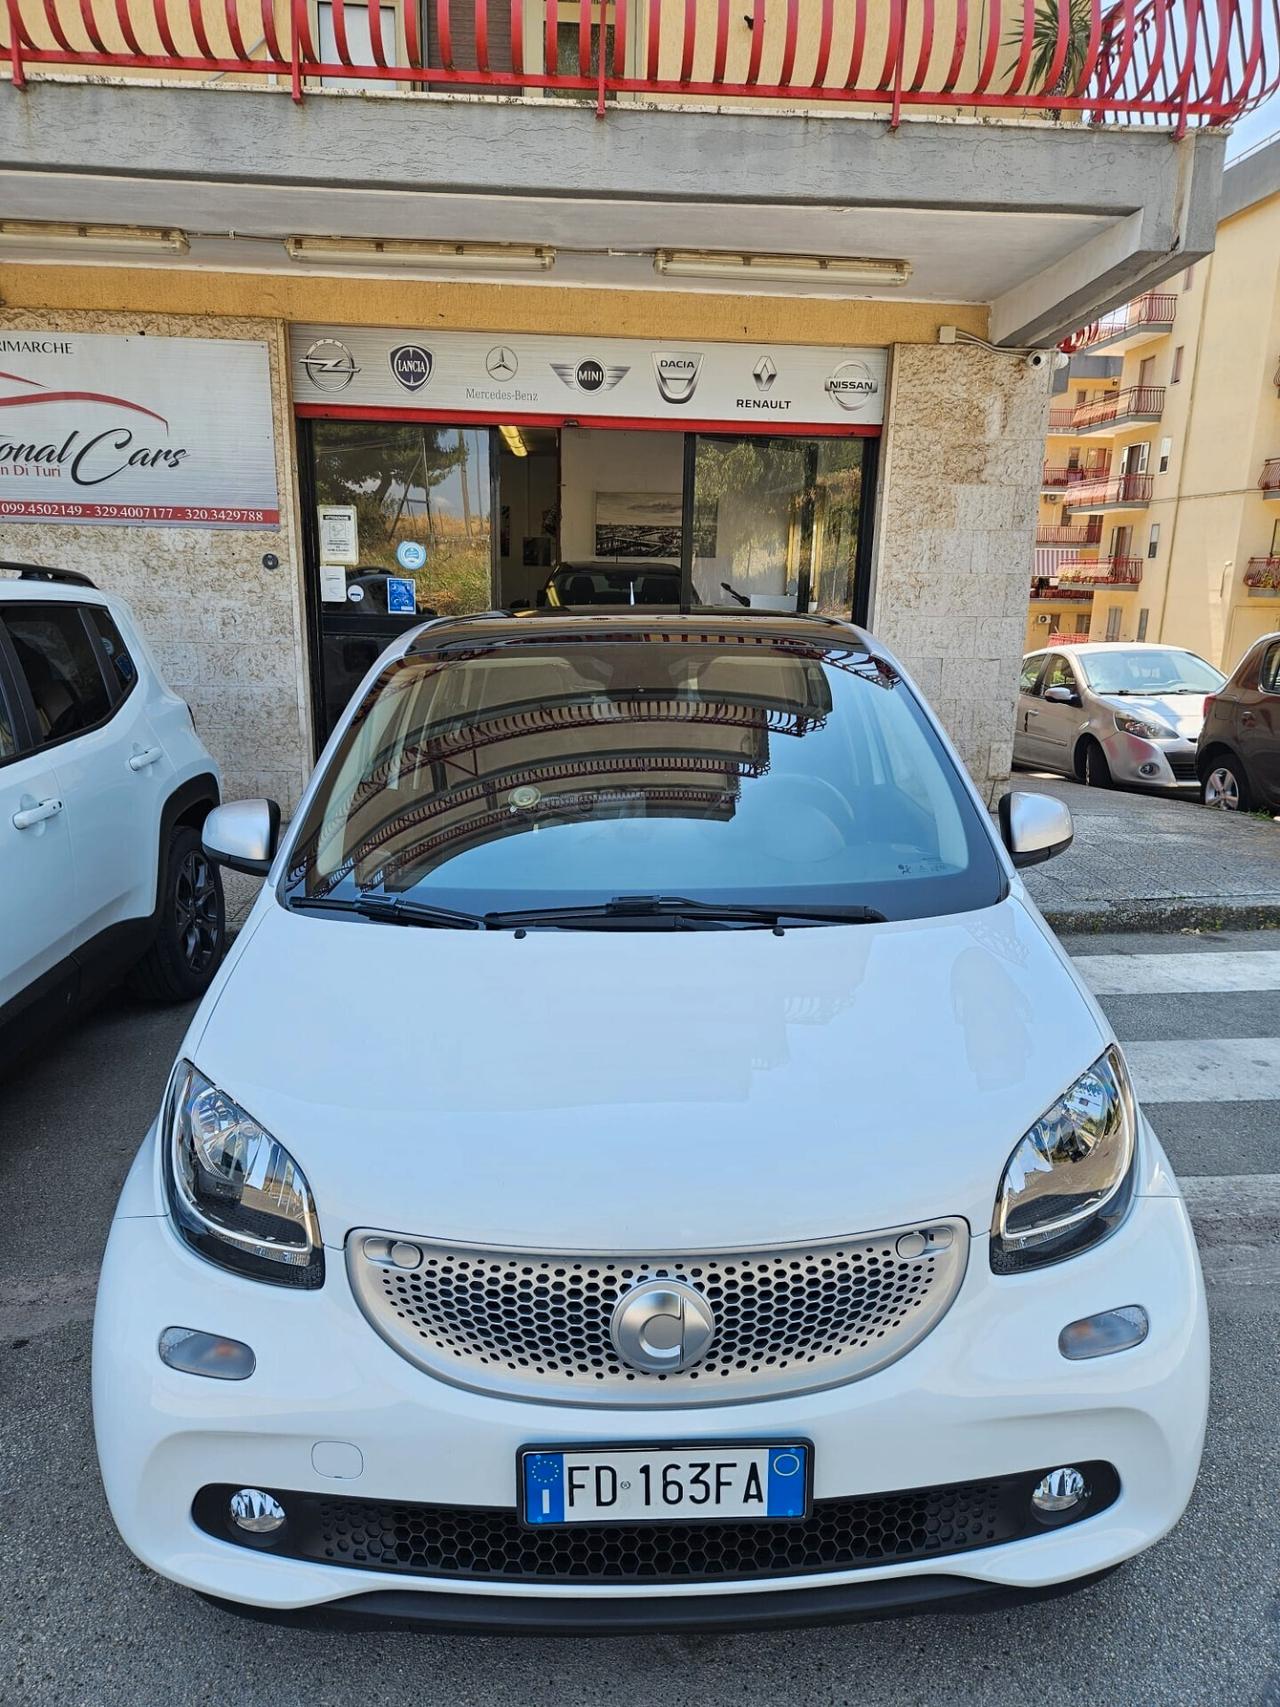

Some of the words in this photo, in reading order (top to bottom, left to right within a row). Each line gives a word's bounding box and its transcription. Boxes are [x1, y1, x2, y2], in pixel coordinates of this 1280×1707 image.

[398, 360, 426, 373] LANCIA
[660, 359, 695, 369] DACIA
[578, 370, 603, 383] MINI
[829, 380, 874, 391] NISSAN
[465, 388, 538, 401] Mercedes-Benz
[736, 399, 792, 410] RENAULT
[71, 428, 190, 486] Cars
[14, 464, 29, 477] Di
[32, 465, 61, 478] Turi
[1, 503, 82, 517] 099.4502149
[94, 506, 173, 520] 329.4007177
[185, 508, 264, 523] 320.3429788
[567, 1466, 617, 1507] FD
[639, 1461, 764, 1507] 163FA
